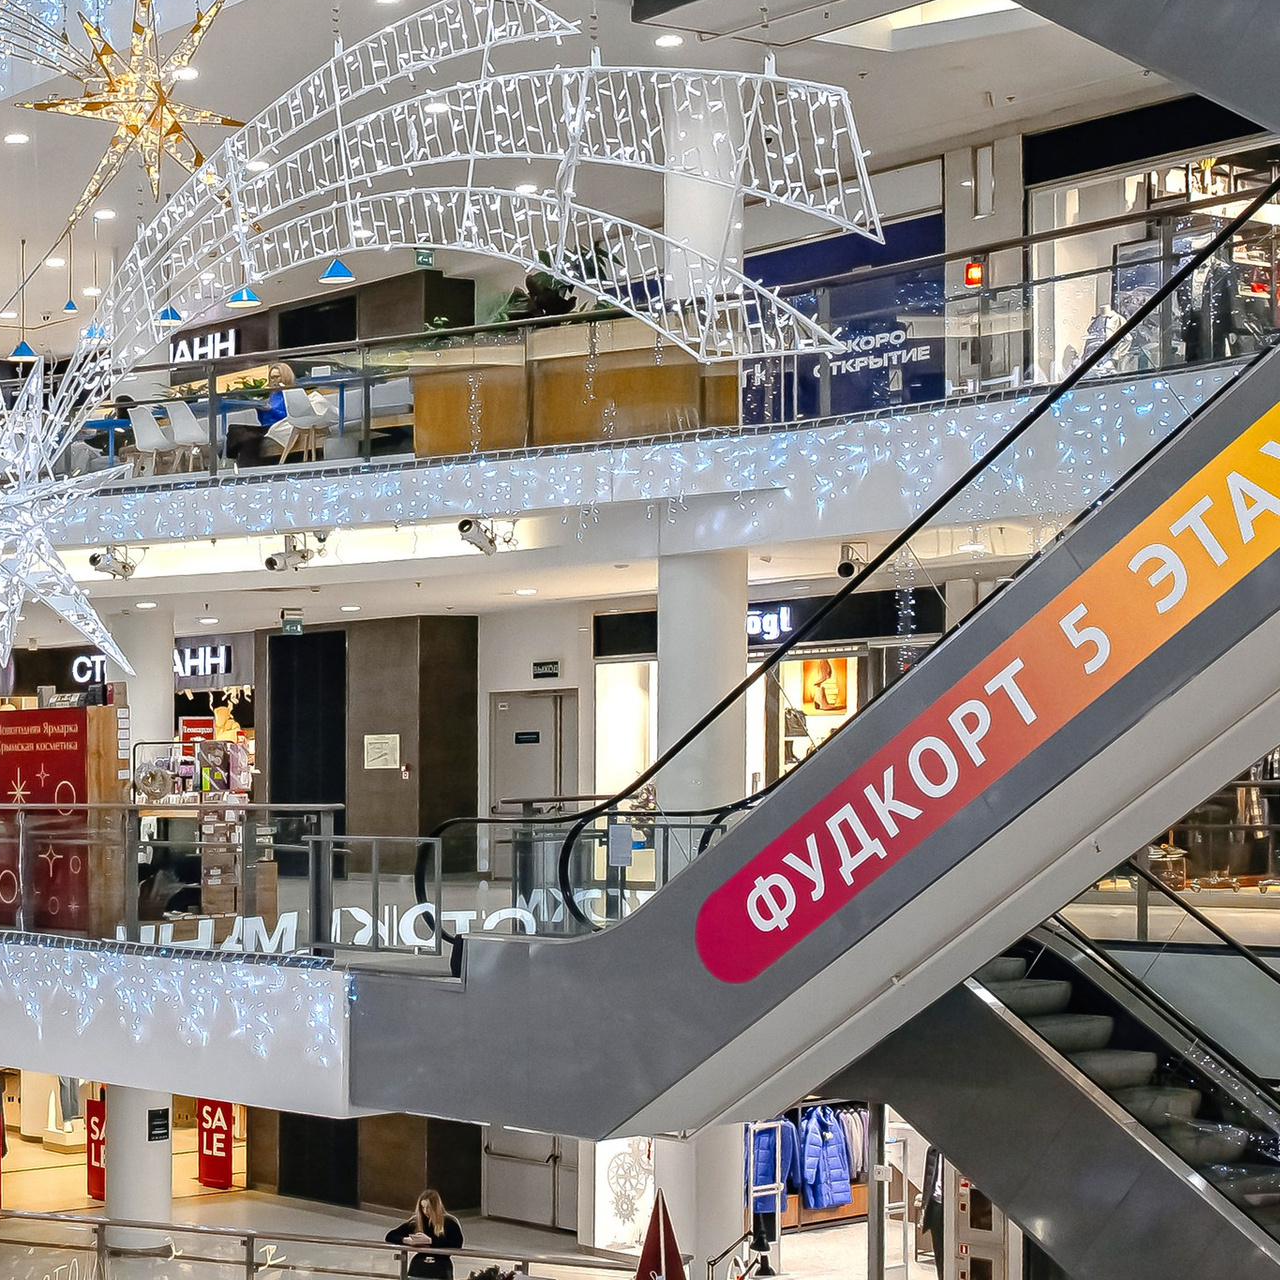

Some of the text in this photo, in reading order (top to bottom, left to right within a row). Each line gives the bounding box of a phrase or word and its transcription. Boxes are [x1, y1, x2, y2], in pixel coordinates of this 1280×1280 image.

[746, 439, 1280, 933] ФУДКОРТ 5 ЭТА
[43, 722, 79, 737] Ярмарка
[36, 741, 78, 752] косметика
[202, 1105, 228, 1131] SA
[202, 1133, 226, 1157] LE
